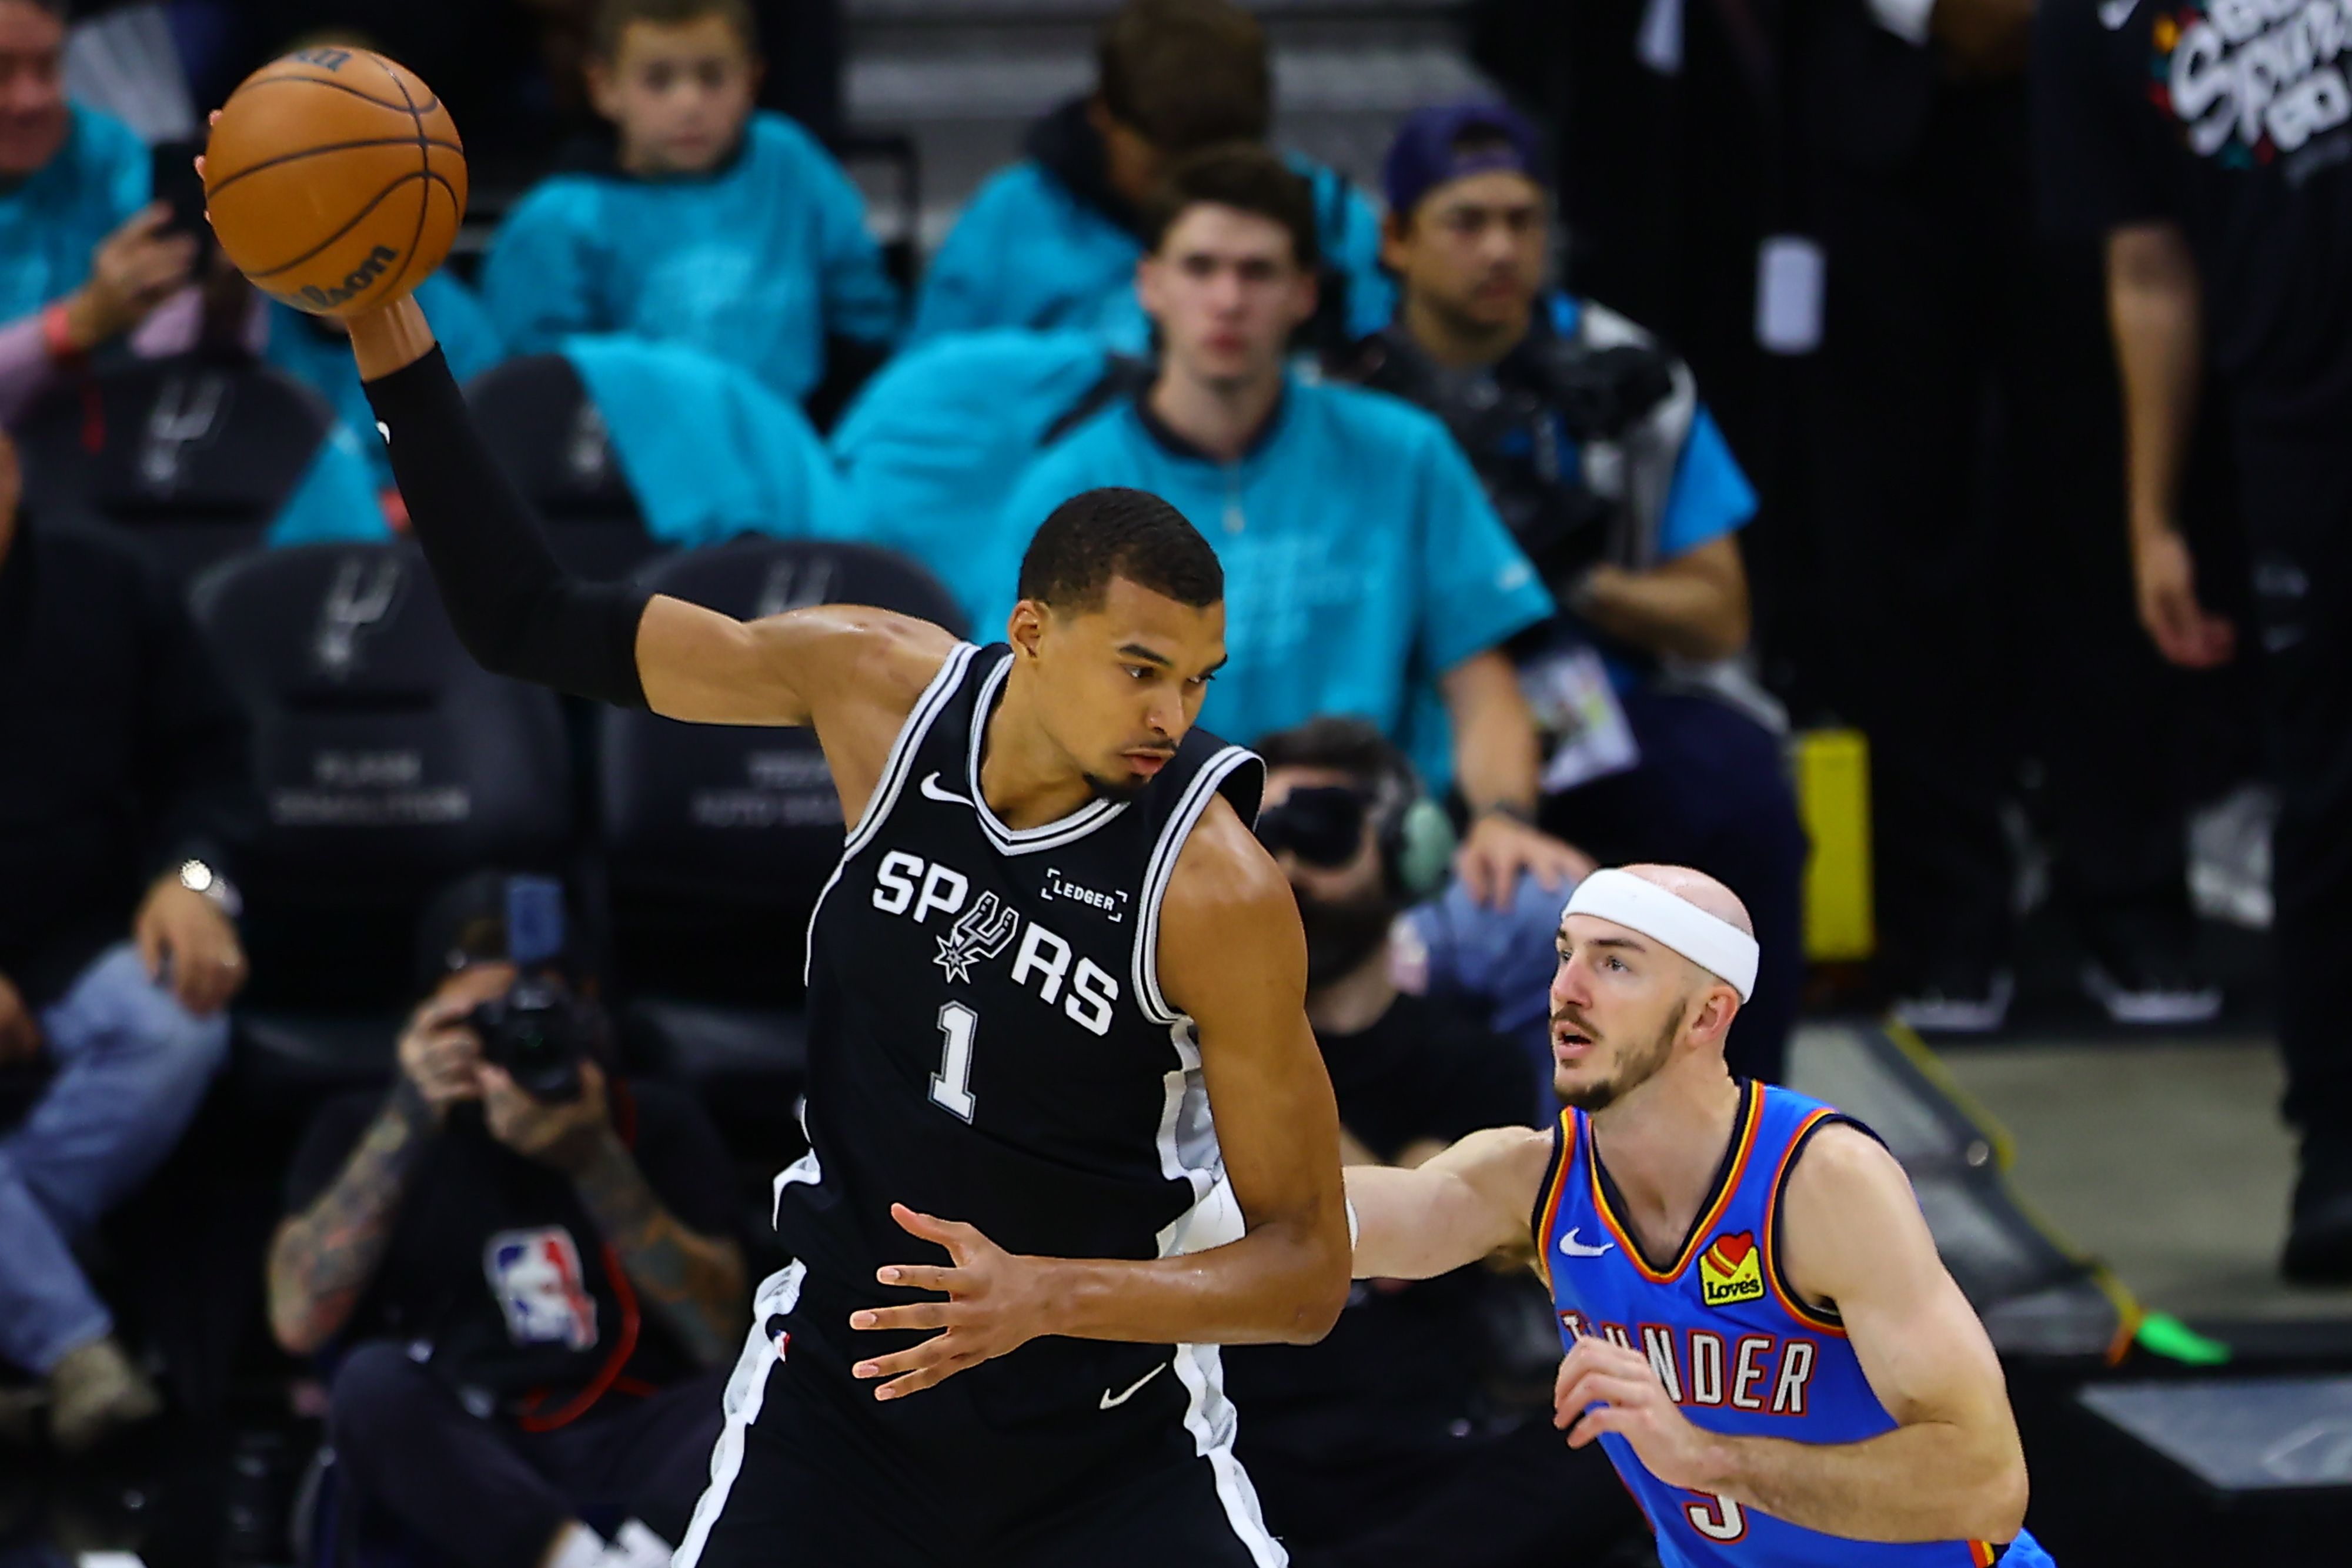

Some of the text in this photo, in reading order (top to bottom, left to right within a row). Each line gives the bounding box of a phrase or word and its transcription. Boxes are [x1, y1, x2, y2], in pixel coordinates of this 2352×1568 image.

[873, 850, 1119, 1038] SPURS
[1053, 878, 1115, 912] LEDGER
[927, 999, 979, 1125] 1
